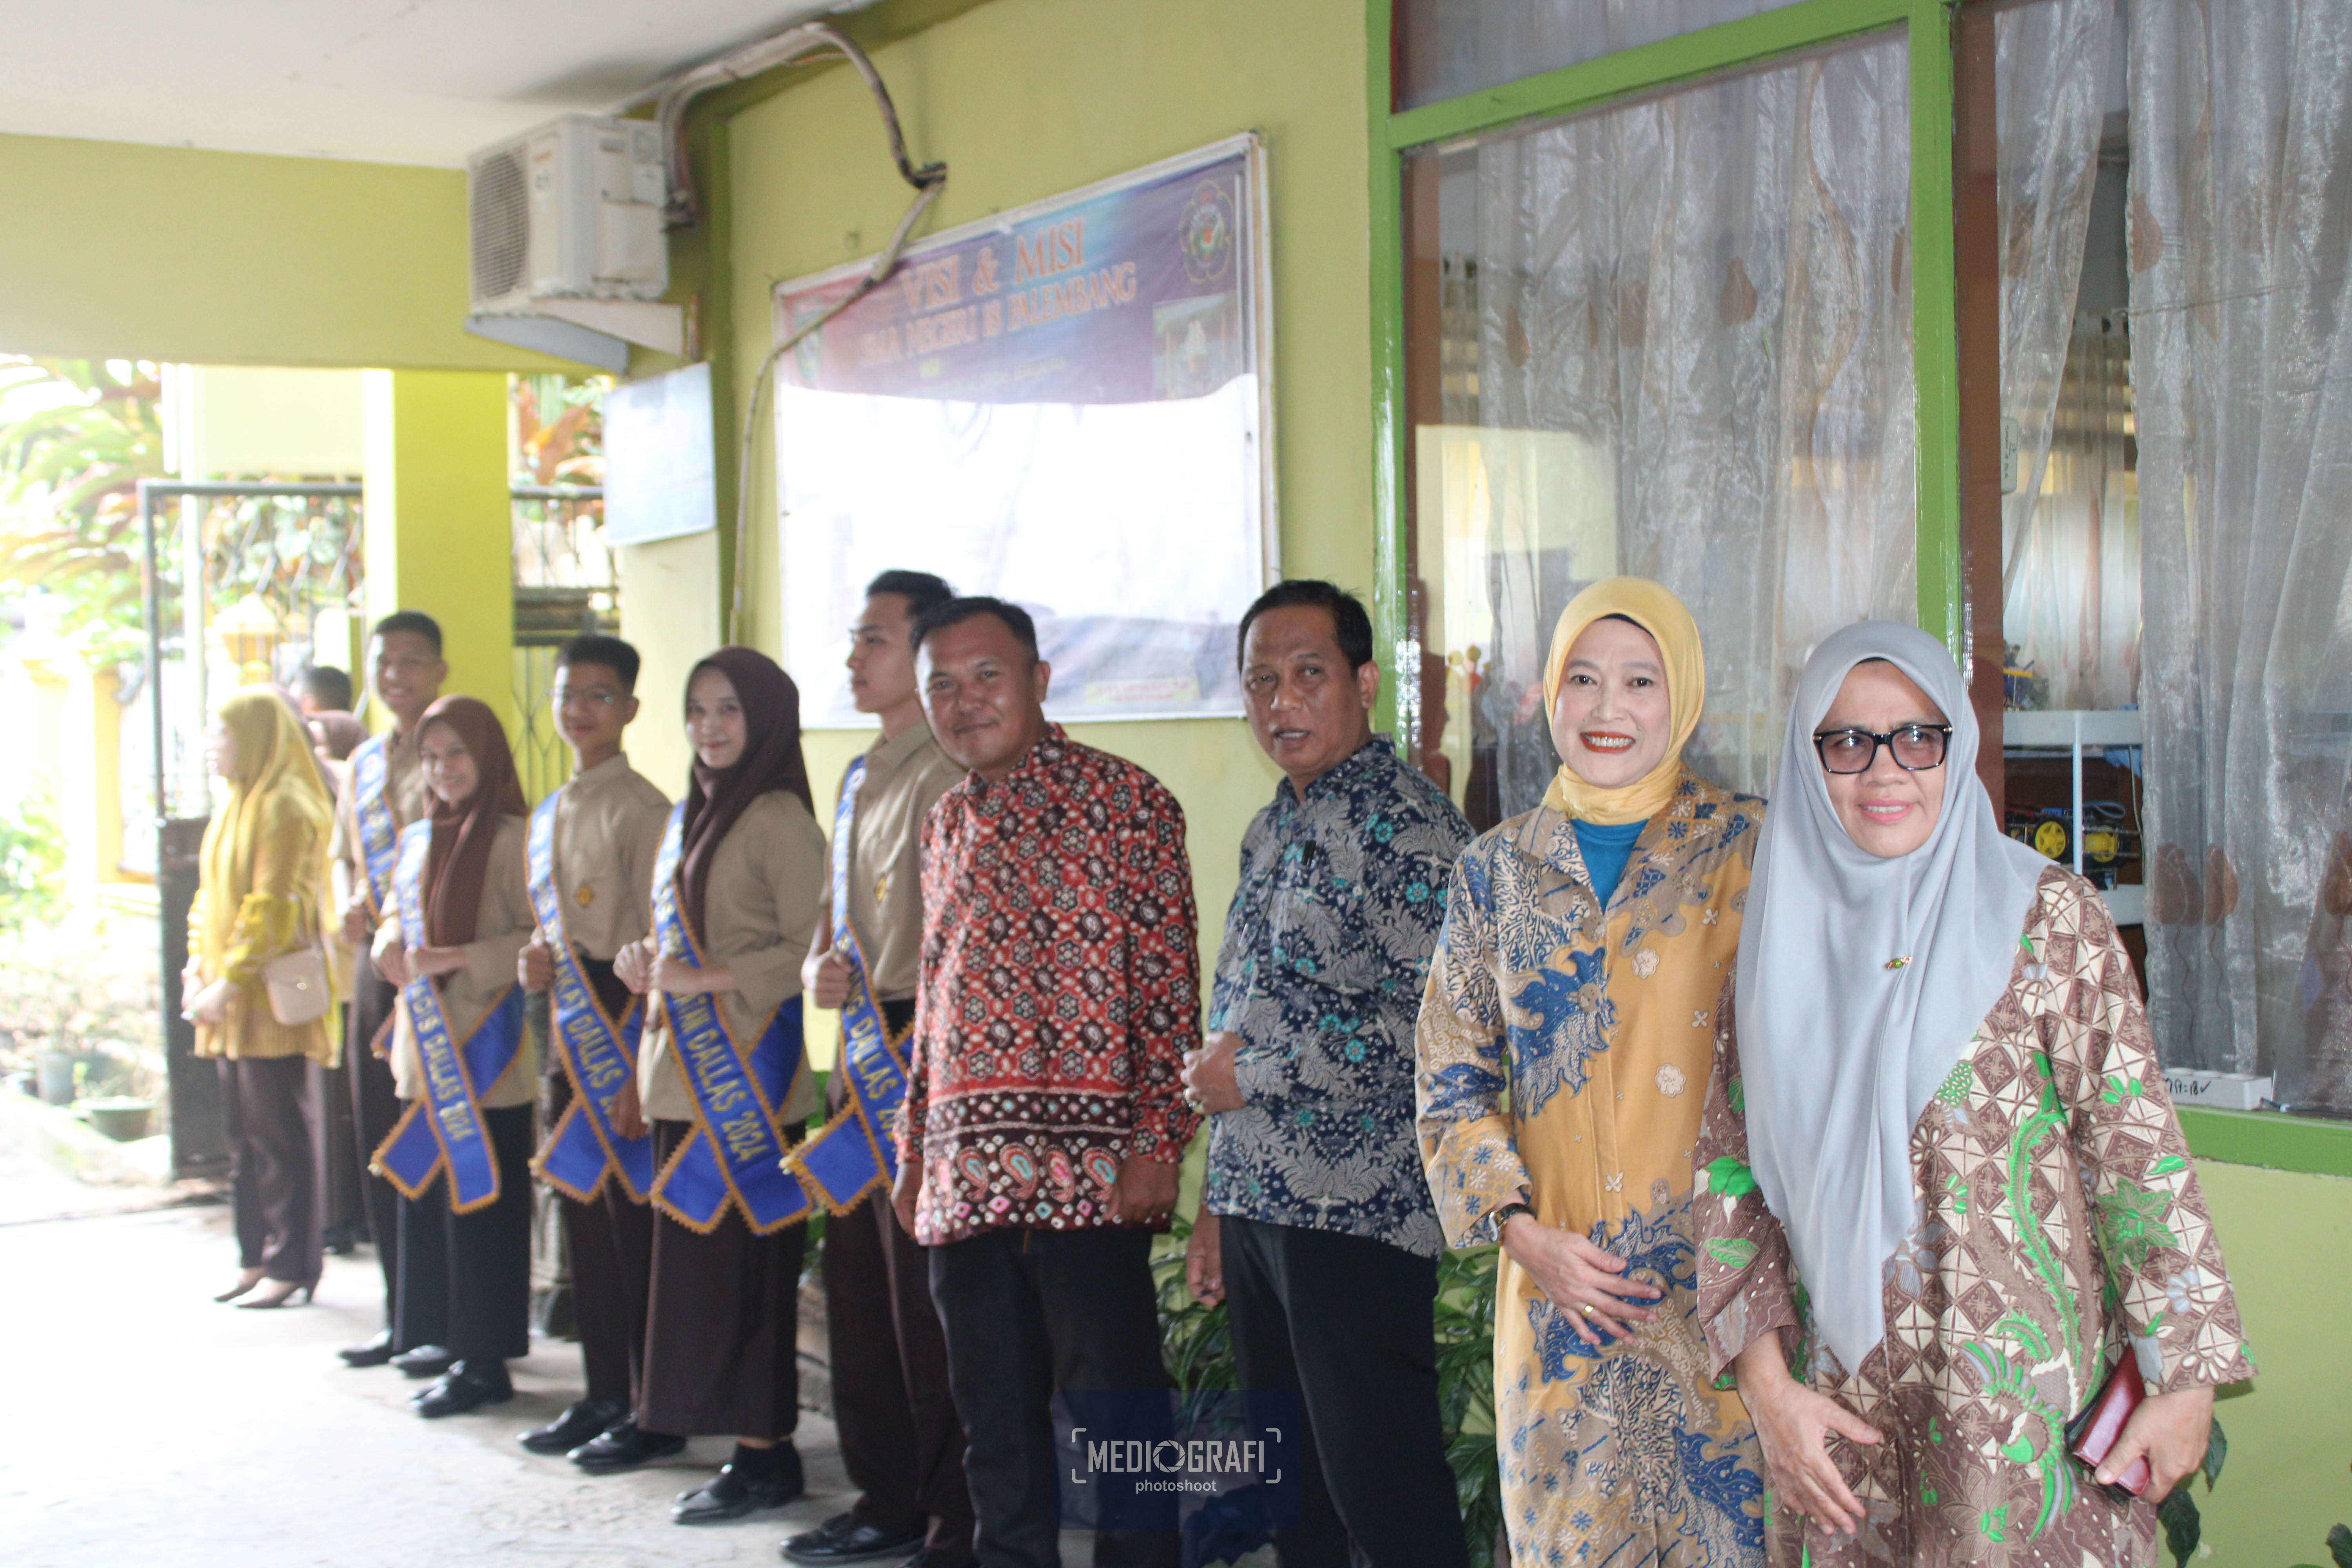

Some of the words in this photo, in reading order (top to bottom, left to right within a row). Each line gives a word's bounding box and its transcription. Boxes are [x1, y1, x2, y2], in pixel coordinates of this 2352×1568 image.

[902, 256, 960, 313] VISI
[973, 247, 1000, 295] &
[1014, 218, 1084, 284] MISI
[1008, 262, 1136, 331] PALEMBANG
[566, 1012, 624, 1089] DALLAS
[686, 1029, 748, 1112] DALLAS
[721, 1110, 769, 1163] 2024
